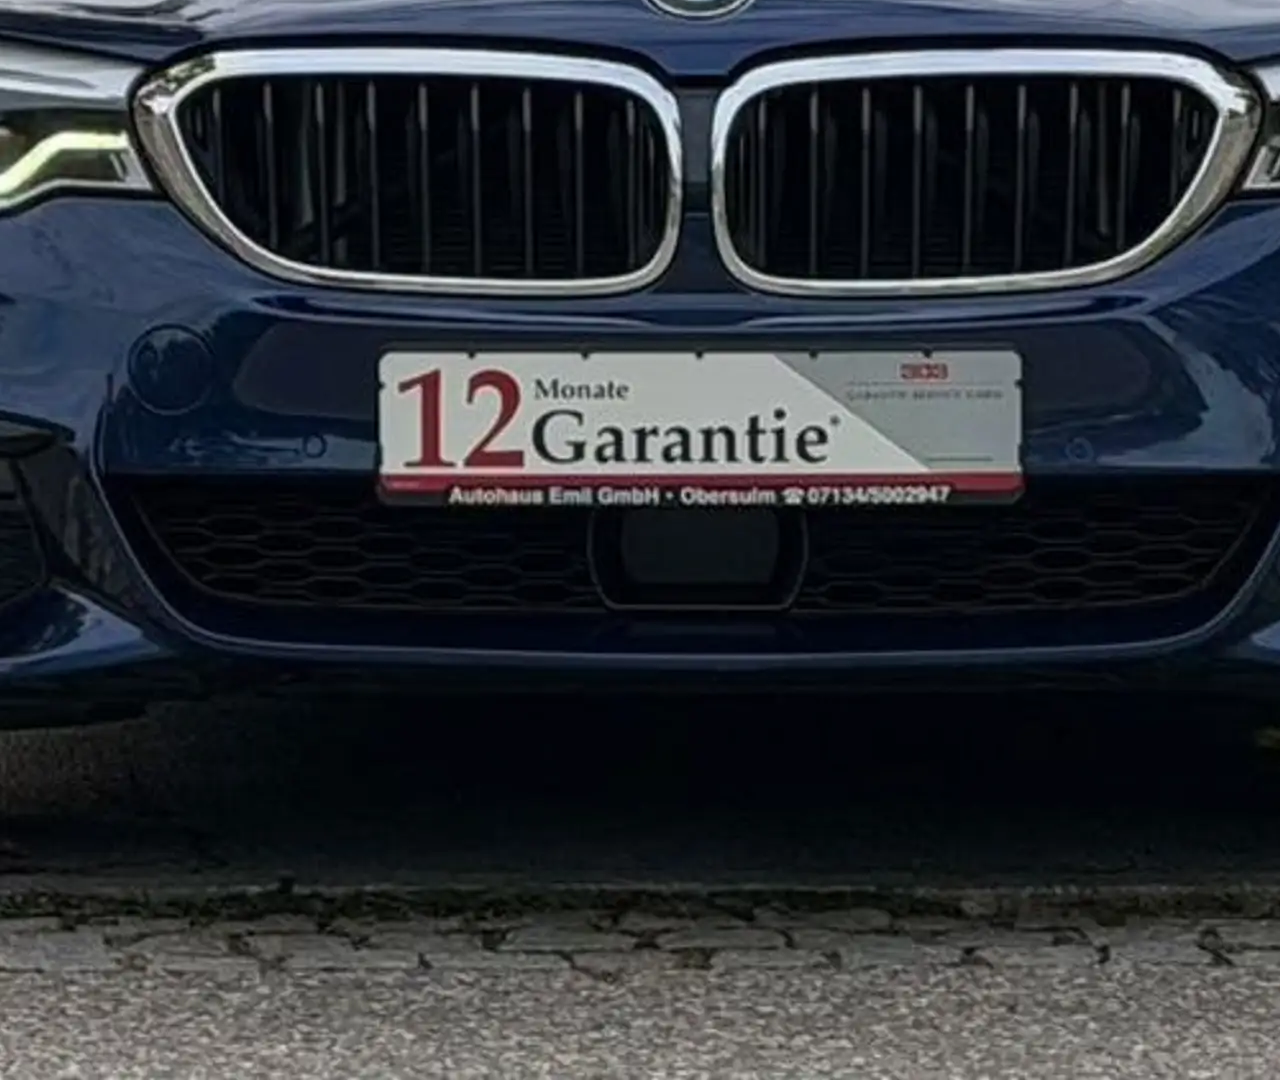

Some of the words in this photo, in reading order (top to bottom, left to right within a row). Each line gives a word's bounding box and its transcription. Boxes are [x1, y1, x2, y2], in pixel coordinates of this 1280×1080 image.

[397, 367, 525, 470] 12
[534, 379, 630, 401] Monate
[448, 485, 545, 506] Autohaus
[548, 486, 594, 506] Emil
[597, 486, 660, 506] GmbH
[680, 486, 777, 506] Obersulm
